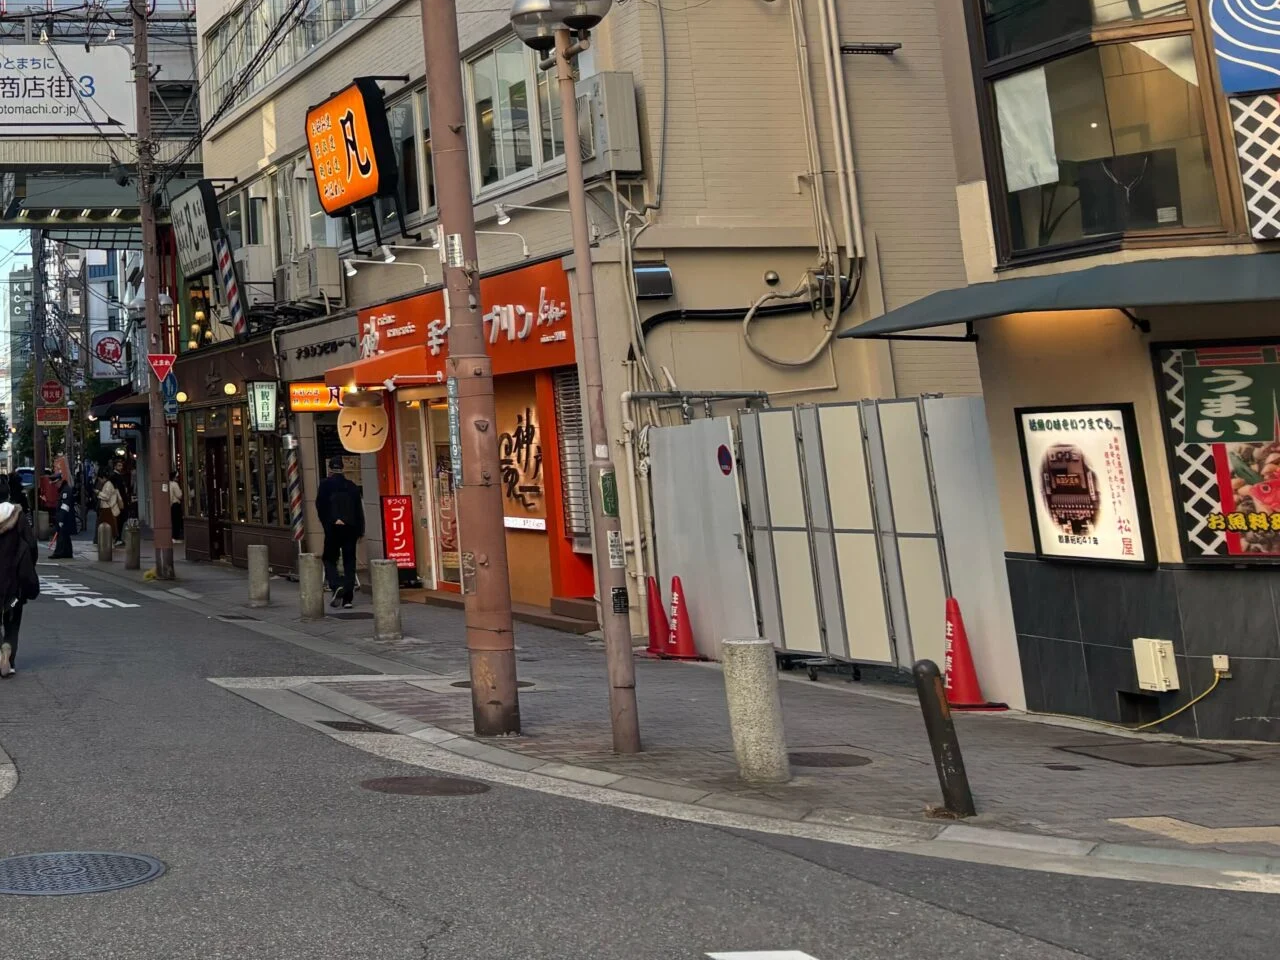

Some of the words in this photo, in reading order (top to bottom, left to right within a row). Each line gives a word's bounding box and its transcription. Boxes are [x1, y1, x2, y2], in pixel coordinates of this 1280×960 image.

[339, 108, 373, 182] 凡
[13, 283, 21, 315] KCC
[483, 304, 533, 344] プリン
[1196, 368, 1259, 439] うまい
[342, 420, 384, 438] プリン
[391, 506, 406, 550] プリン
